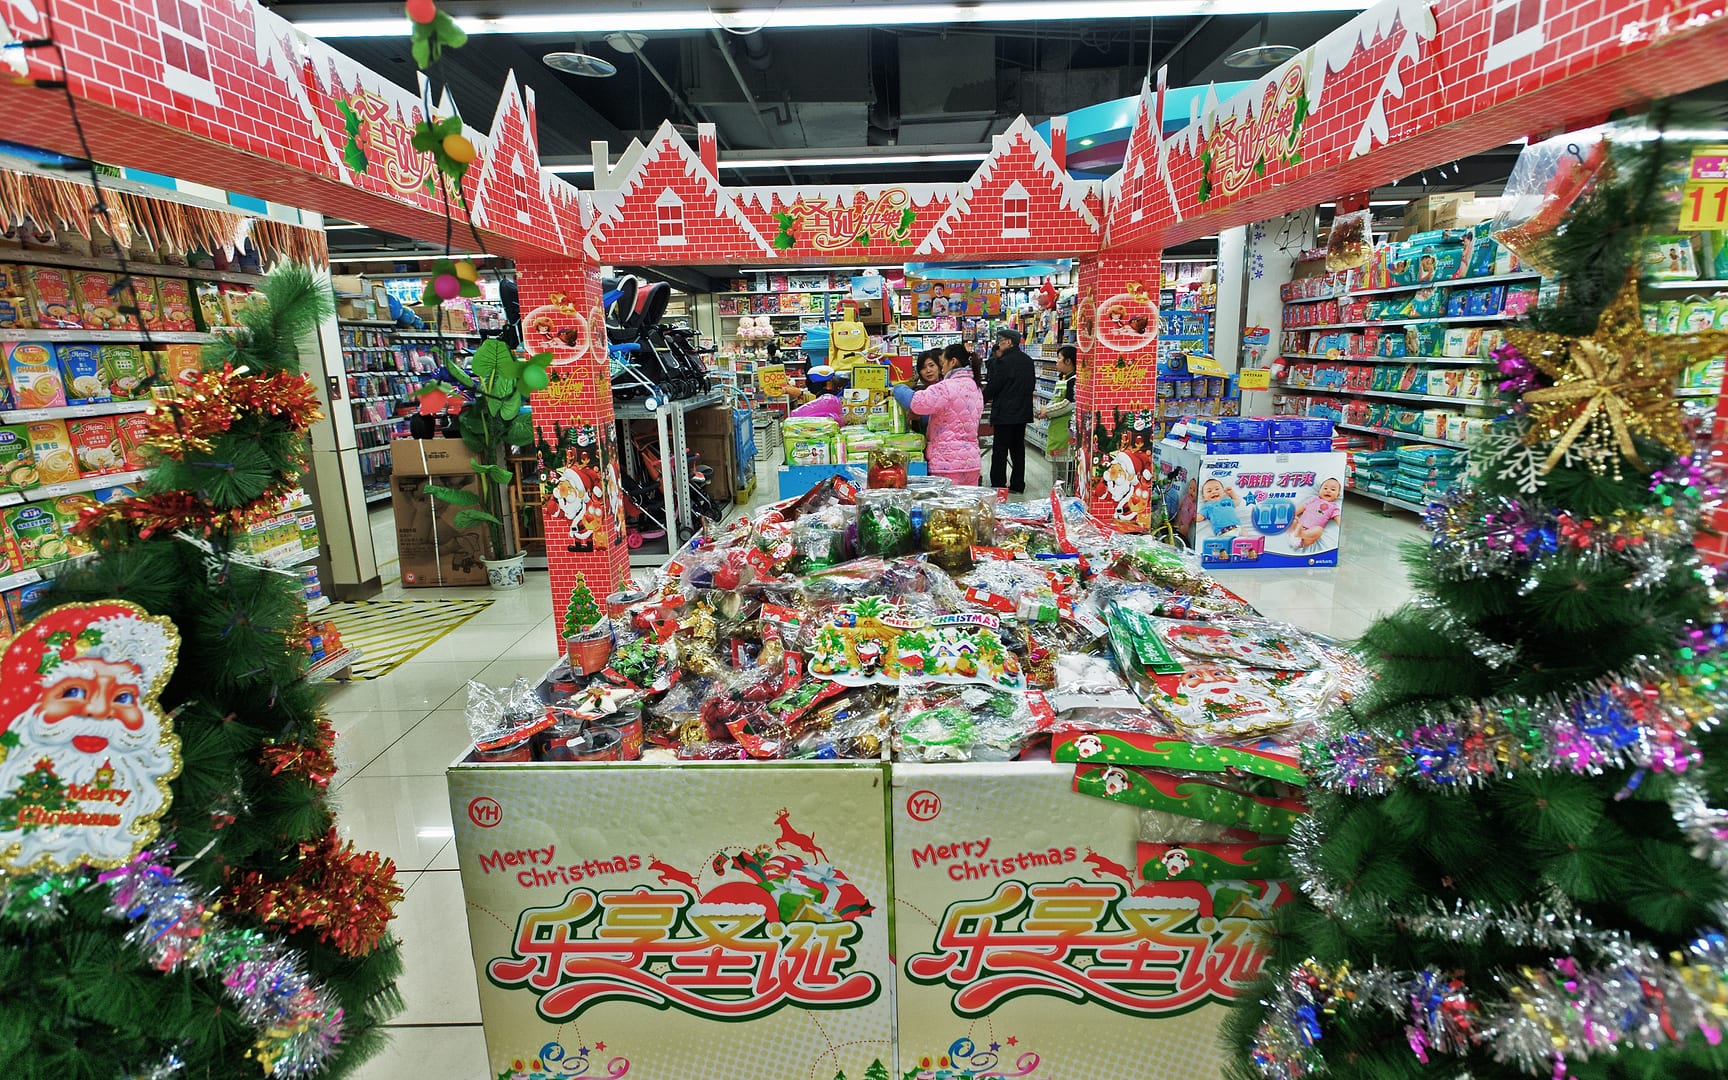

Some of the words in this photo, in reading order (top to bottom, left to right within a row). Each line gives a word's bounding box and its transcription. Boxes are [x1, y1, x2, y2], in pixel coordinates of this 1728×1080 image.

[932, 612, 999, 628] CHRISTMAS
[64, 783, 132, 807] Merry
[913, 798, 937, 815] YH
[474, 803, 499, 822] YH
[478, 844, 556, 874] Merry
[911, 837, 992, 869] Merry
[947, 846, 1077, 881] Christmas
[516, 854, 642, 888] Christmas
[487, 885, 881, 1022] 乐享圣诞
